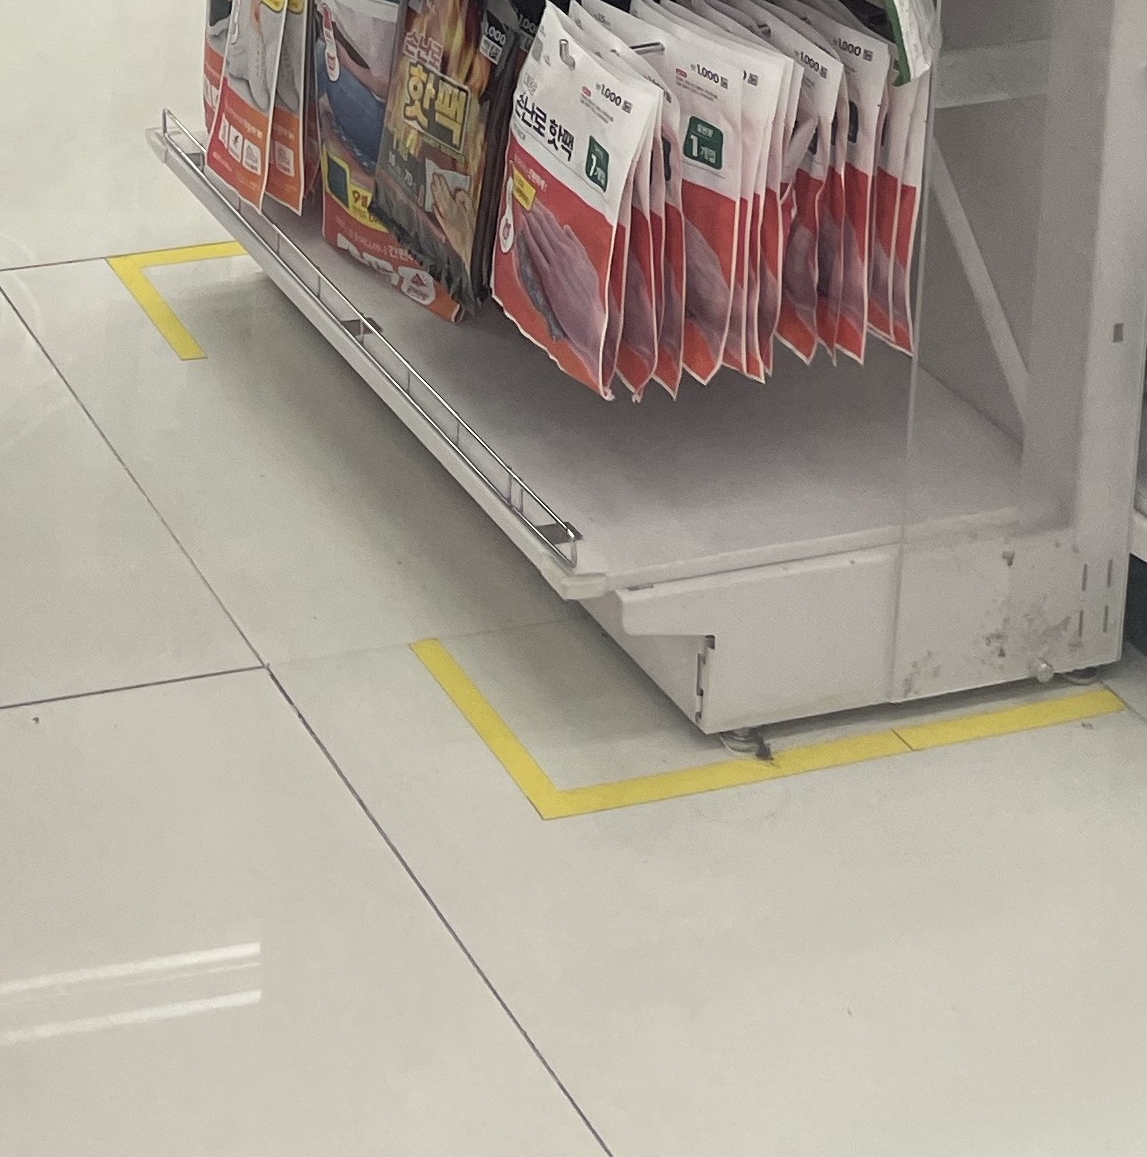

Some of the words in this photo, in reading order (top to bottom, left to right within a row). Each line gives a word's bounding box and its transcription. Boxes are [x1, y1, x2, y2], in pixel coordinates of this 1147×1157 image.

[405, 28, 444, 71] 손난로
[405, 64, 467, 147] 핫팩
[514, 93, 547, 137] 손난로
[548, 118, 575, 162] 핫팩
